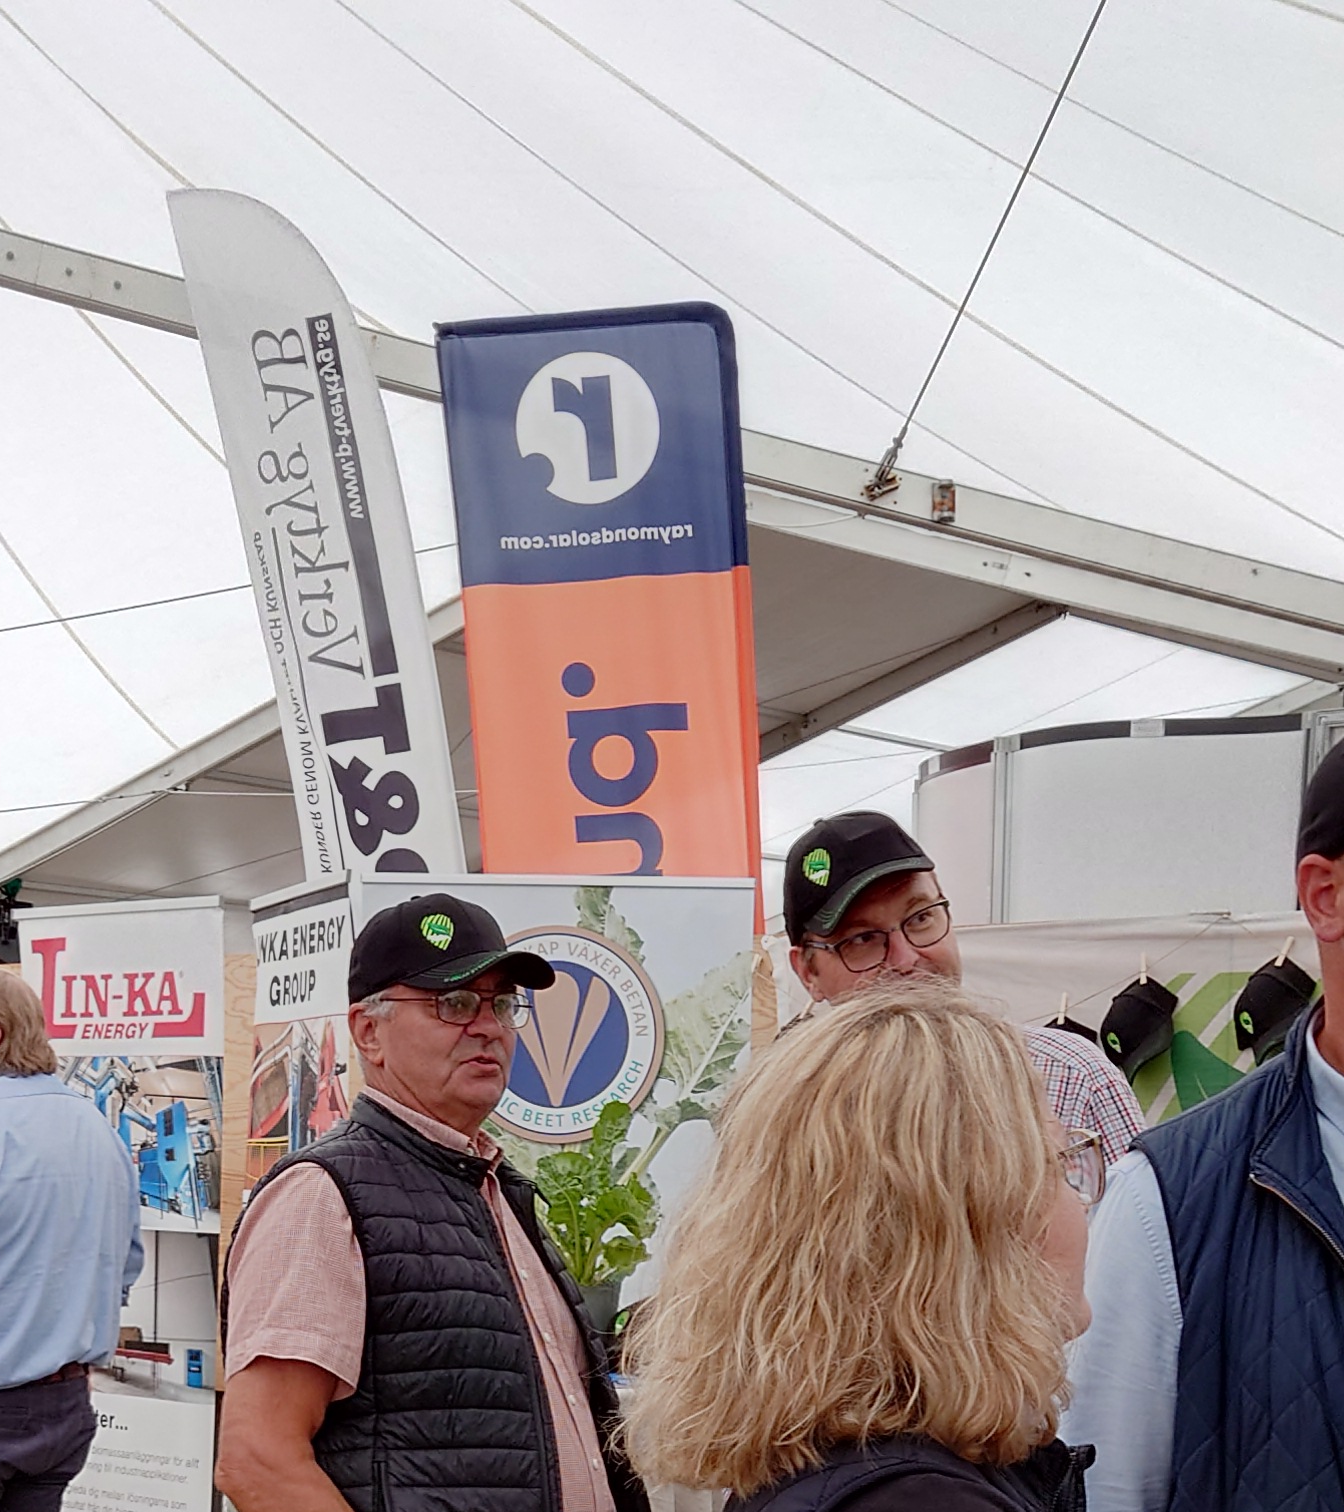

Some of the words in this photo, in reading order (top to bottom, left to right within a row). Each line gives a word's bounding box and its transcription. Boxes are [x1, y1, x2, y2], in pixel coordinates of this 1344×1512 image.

[292, 915, 346, 958] ENERGY
[269, 969, 316, 1007] GROUP
[567, 941, 622, 980] VÄXER
[619, 978, 649, 1038] BETAN
[81, 1022, 150, 1039] ENERGY
[522, 1107, 566, 1128] BEET
